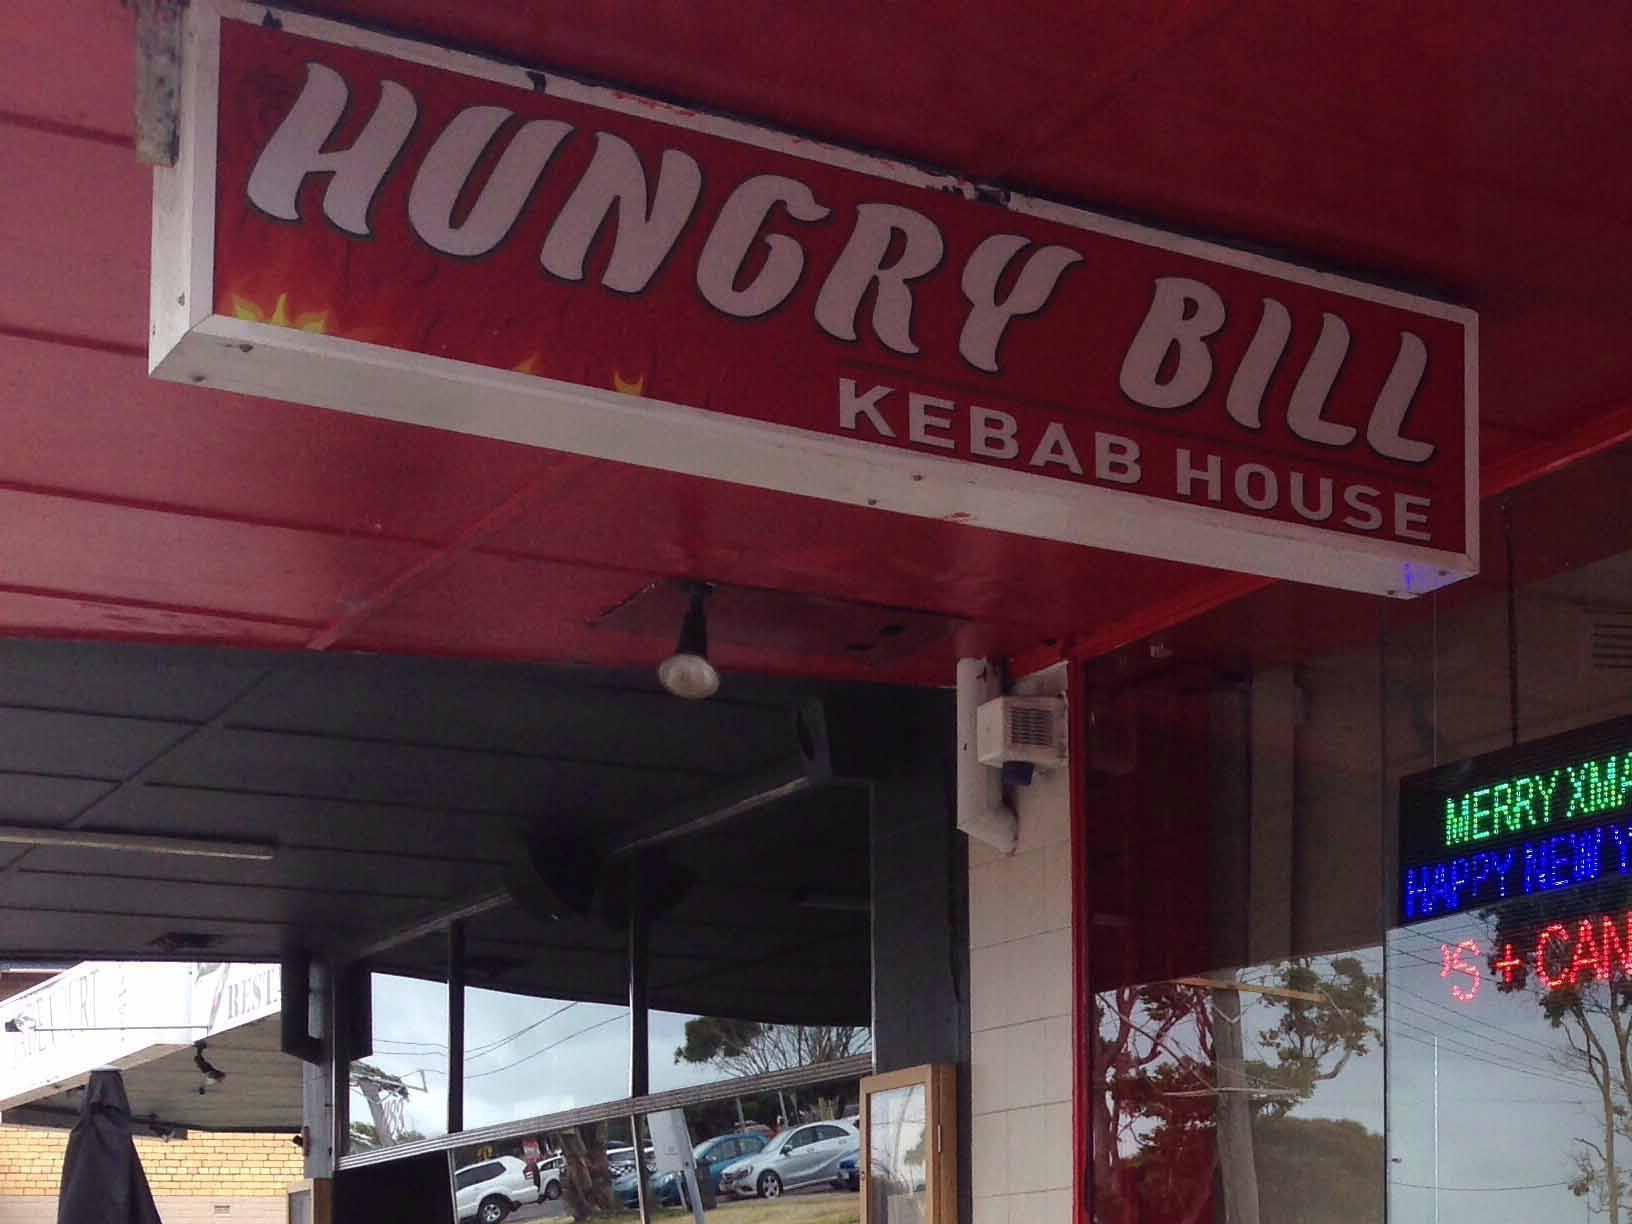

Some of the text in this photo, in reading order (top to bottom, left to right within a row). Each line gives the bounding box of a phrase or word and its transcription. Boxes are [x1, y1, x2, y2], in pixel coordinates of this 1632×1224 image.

[246, 61, 1437, 464] HUNGRY BILL
[838, 377, 1432, 542] KEBAB HOUSE
[1445, 769, 1560, 847] MERRY
[1406, 846, 1516, 920] HAPPY
[1523, 828, 1601, 895] NEW
